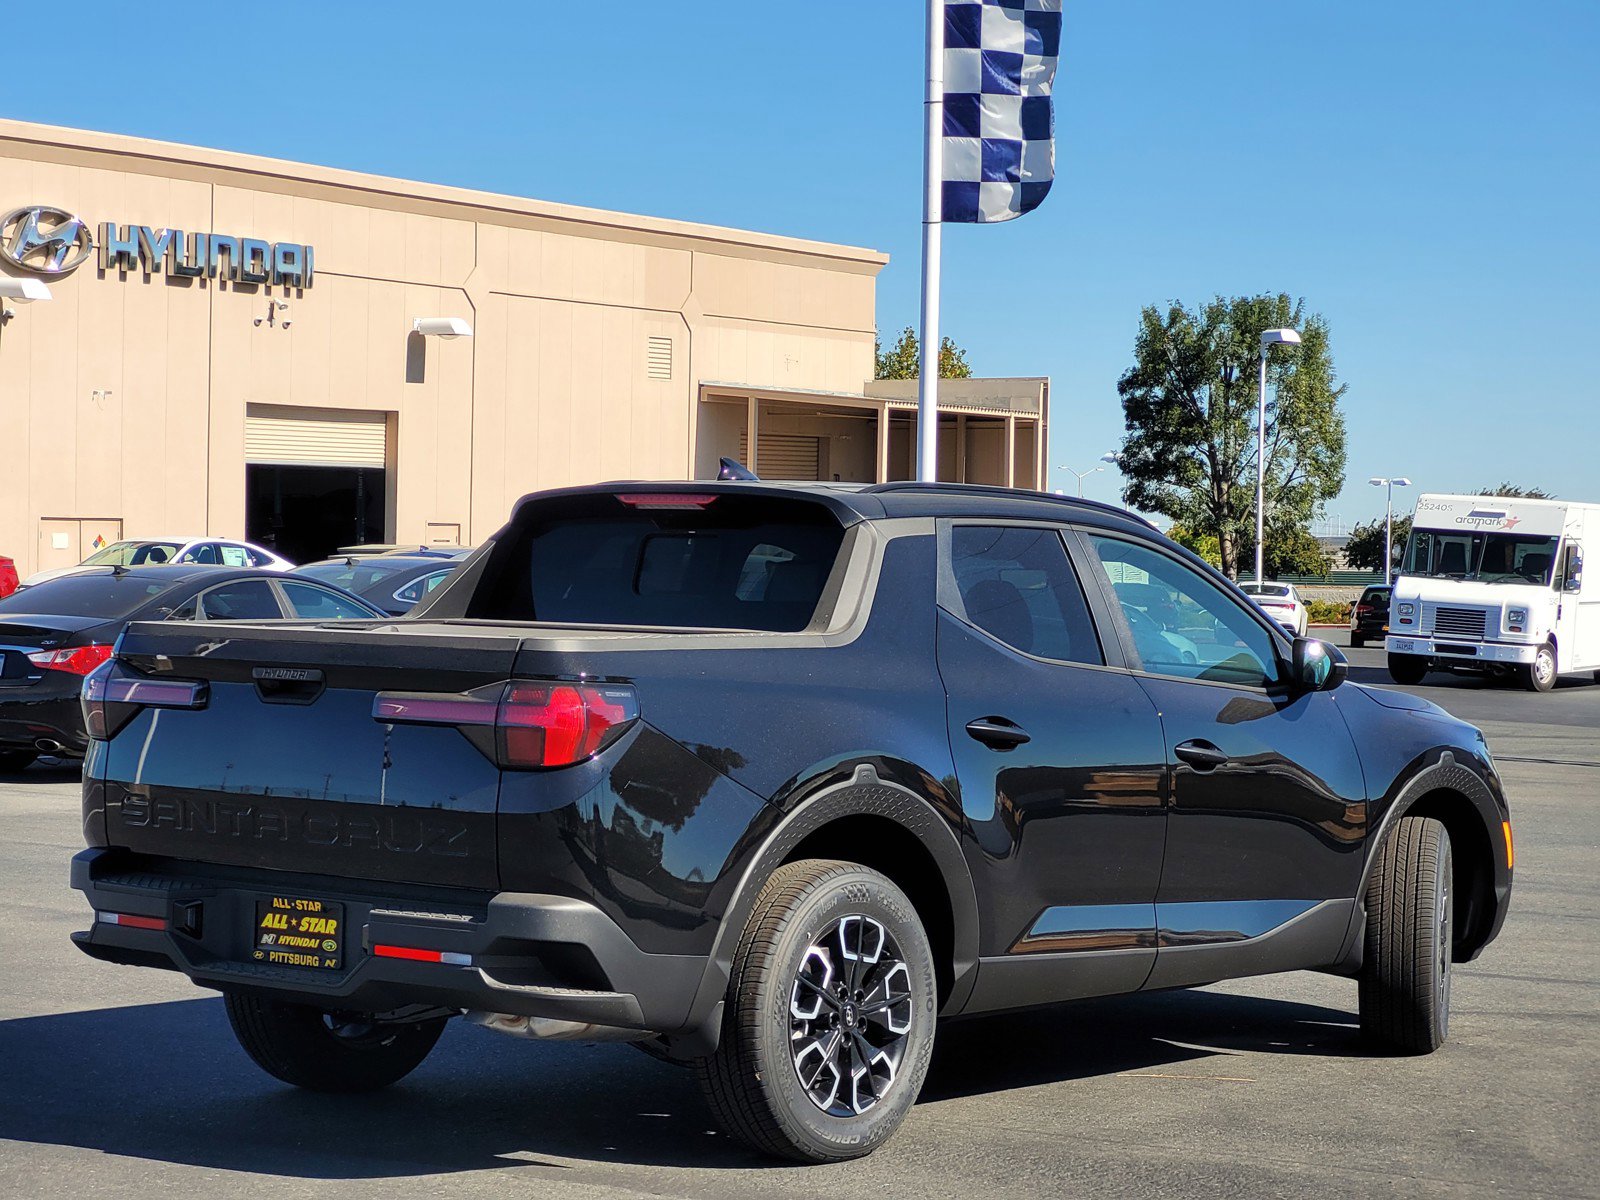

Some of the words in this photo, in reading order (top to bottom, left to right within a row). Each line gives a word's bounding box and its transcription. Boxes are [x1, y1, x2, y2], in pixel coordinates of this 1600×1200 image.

[99, 222, 314, 289] HYUNDAI
[1455, 516, 1502, 526] aramark
[261, 669, 308, 680] HYUNDAI
[121, 797, 289, 841] SANTA
[302, 813, 471, 858] CRUZ
[273, 897, 291, 909] ALL
[296, 899, 321, 912] STAR
[261, 913, 288, 929] ALL
[299, 917, 337, 934] STAR
[278, 935, 319, 948] HYUNDAI
[269, 951, 319, 967] PITTSBURG
